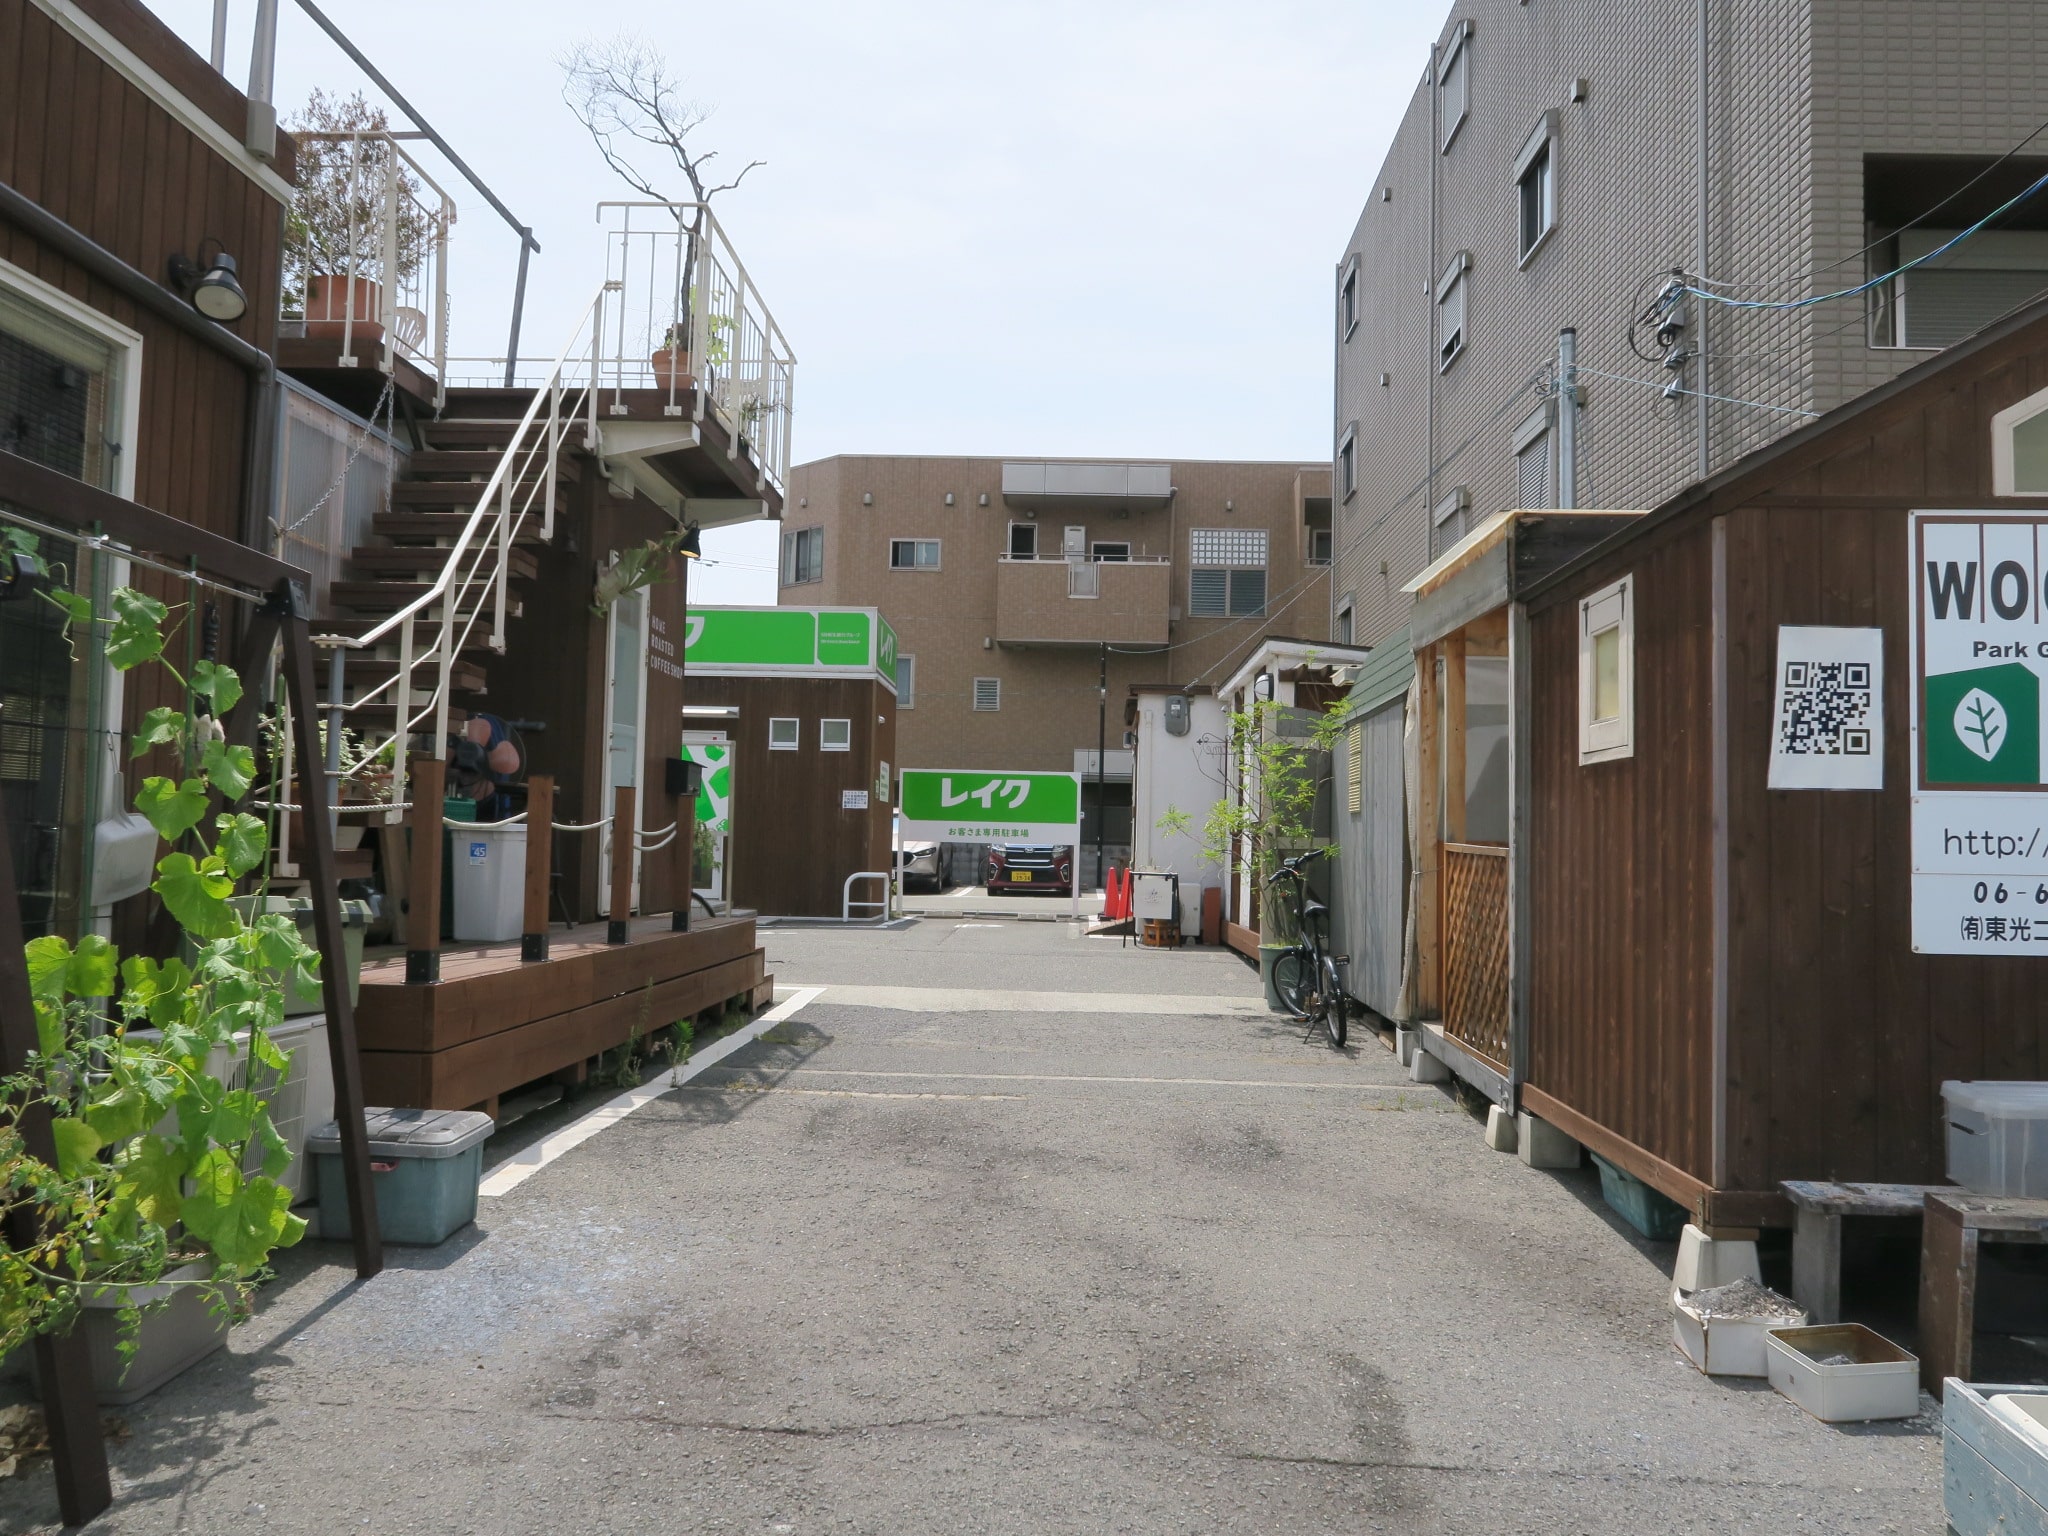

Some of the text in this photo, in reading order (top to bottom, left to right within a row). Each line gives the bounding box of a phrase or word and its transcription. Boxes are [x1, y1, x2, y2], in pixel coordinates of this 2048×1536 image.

[1927, 560, 2048, 621] WO
[651, 633, 674, 657] ROASTED
[1972, 640, 2029, 658] Park
[650, 654, 671, 676] COFFEE
[941, 777, 1031, 809] レイク
[948, 827, 1030, 838] お客さま専用駐車場
[473, 847, 486, 857] 45
